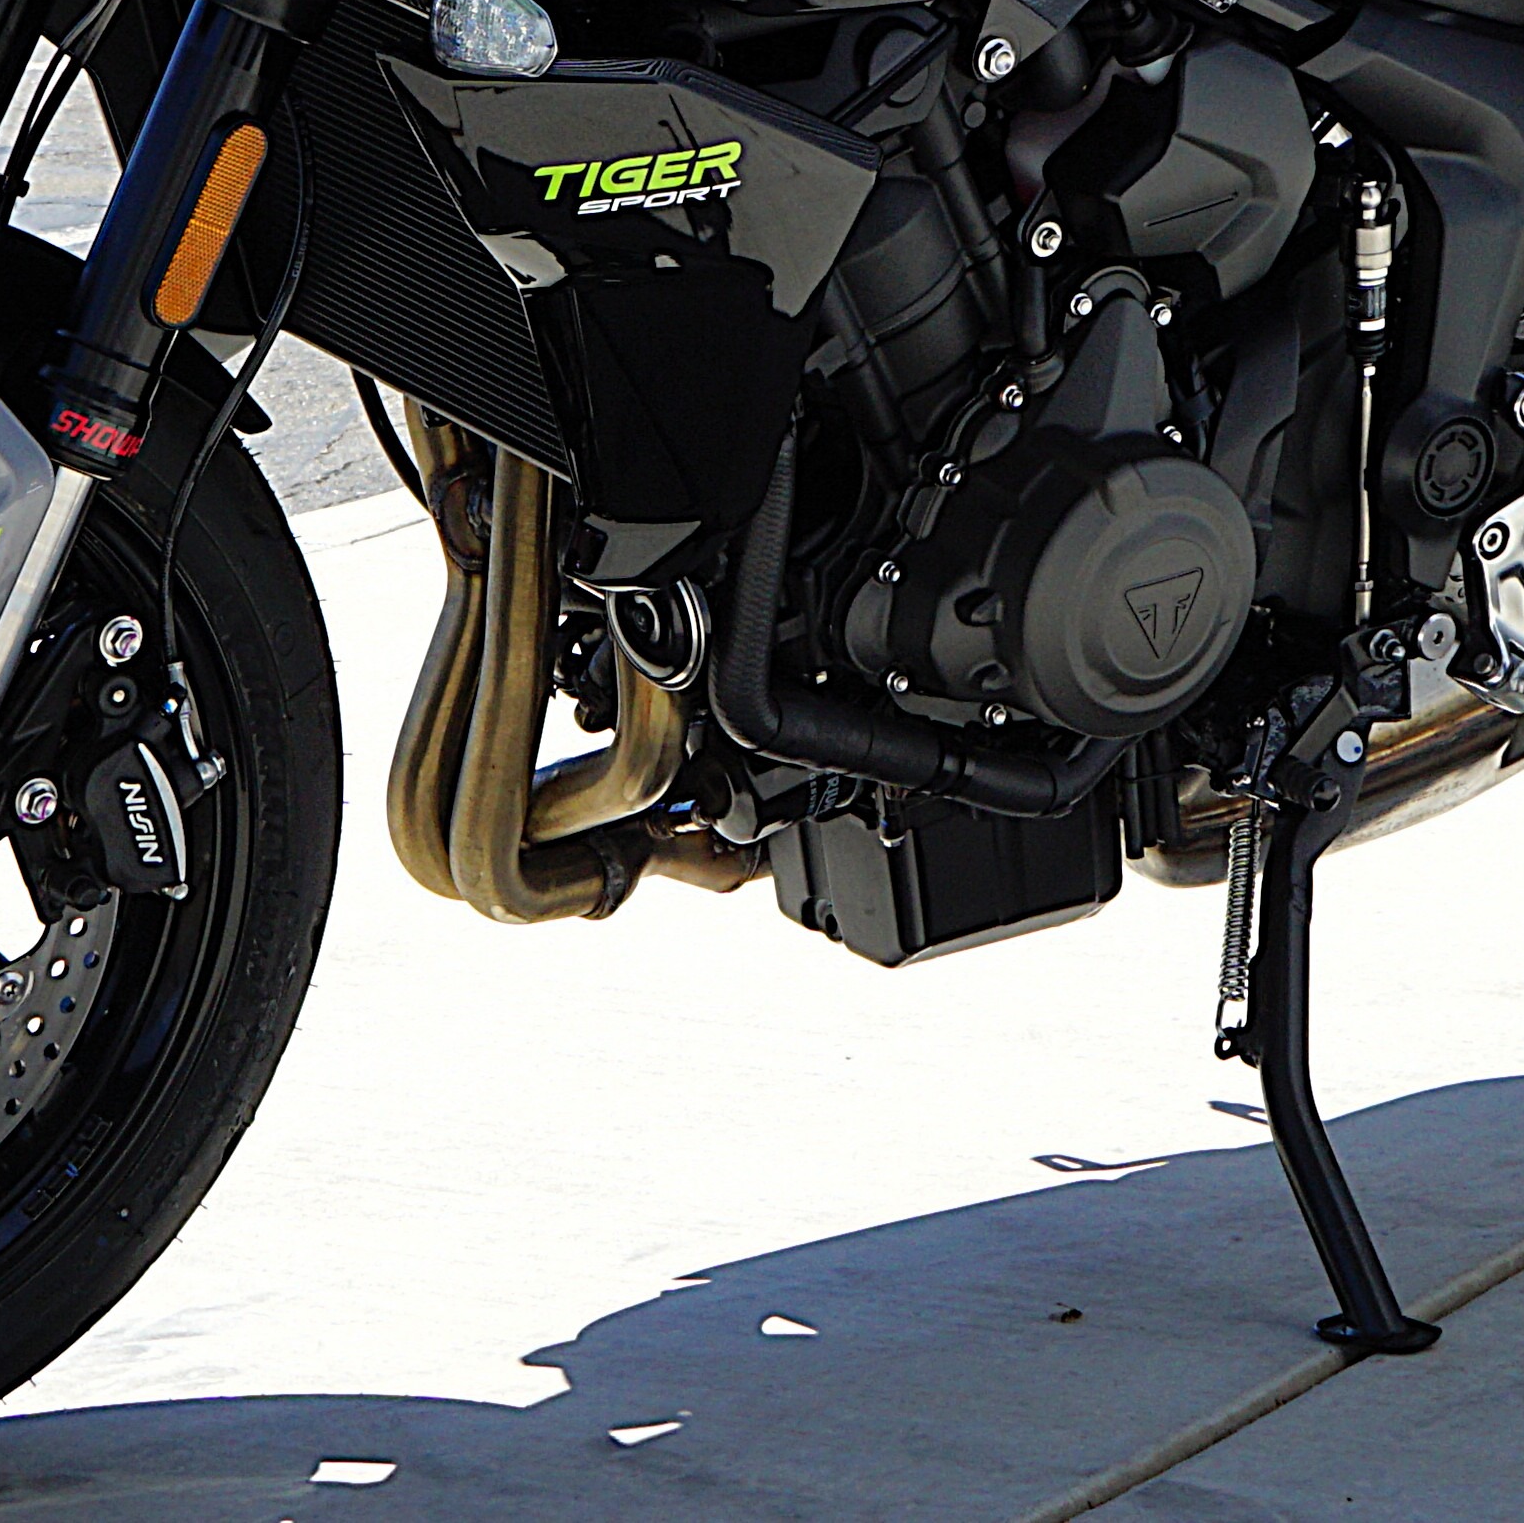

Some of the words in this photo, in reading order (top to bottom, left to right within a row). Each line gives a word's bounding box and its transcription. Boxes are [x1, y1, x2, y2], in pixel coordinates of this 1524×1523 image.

[533, 140, 742, 201] TIGER
[577, 180, 742, 215] SPORT
[119, 781, 164, 863] NISSIN
